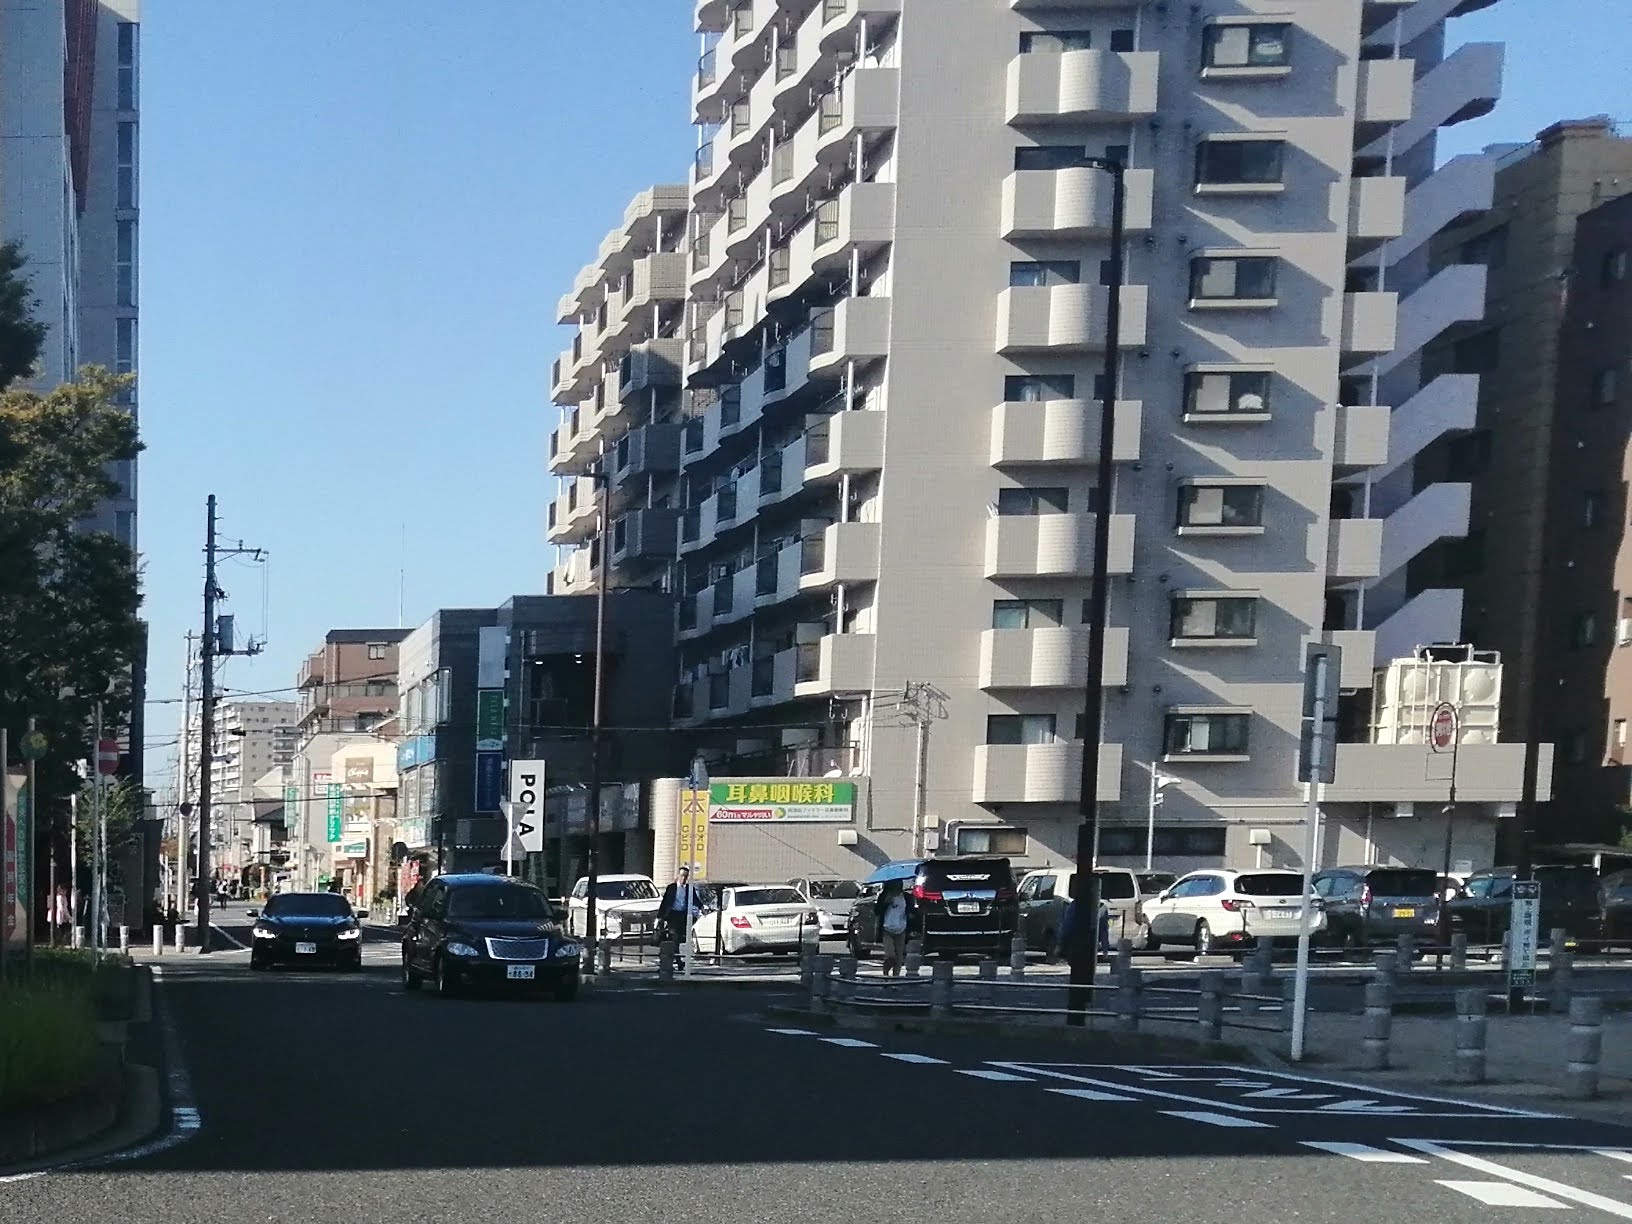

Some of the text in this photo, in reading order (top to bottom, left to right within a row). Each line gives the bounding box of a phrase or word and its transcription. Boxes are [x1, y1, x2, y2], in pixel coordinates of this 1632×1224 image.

[726, 783, 834, 804] 耳鼻咽喉科
